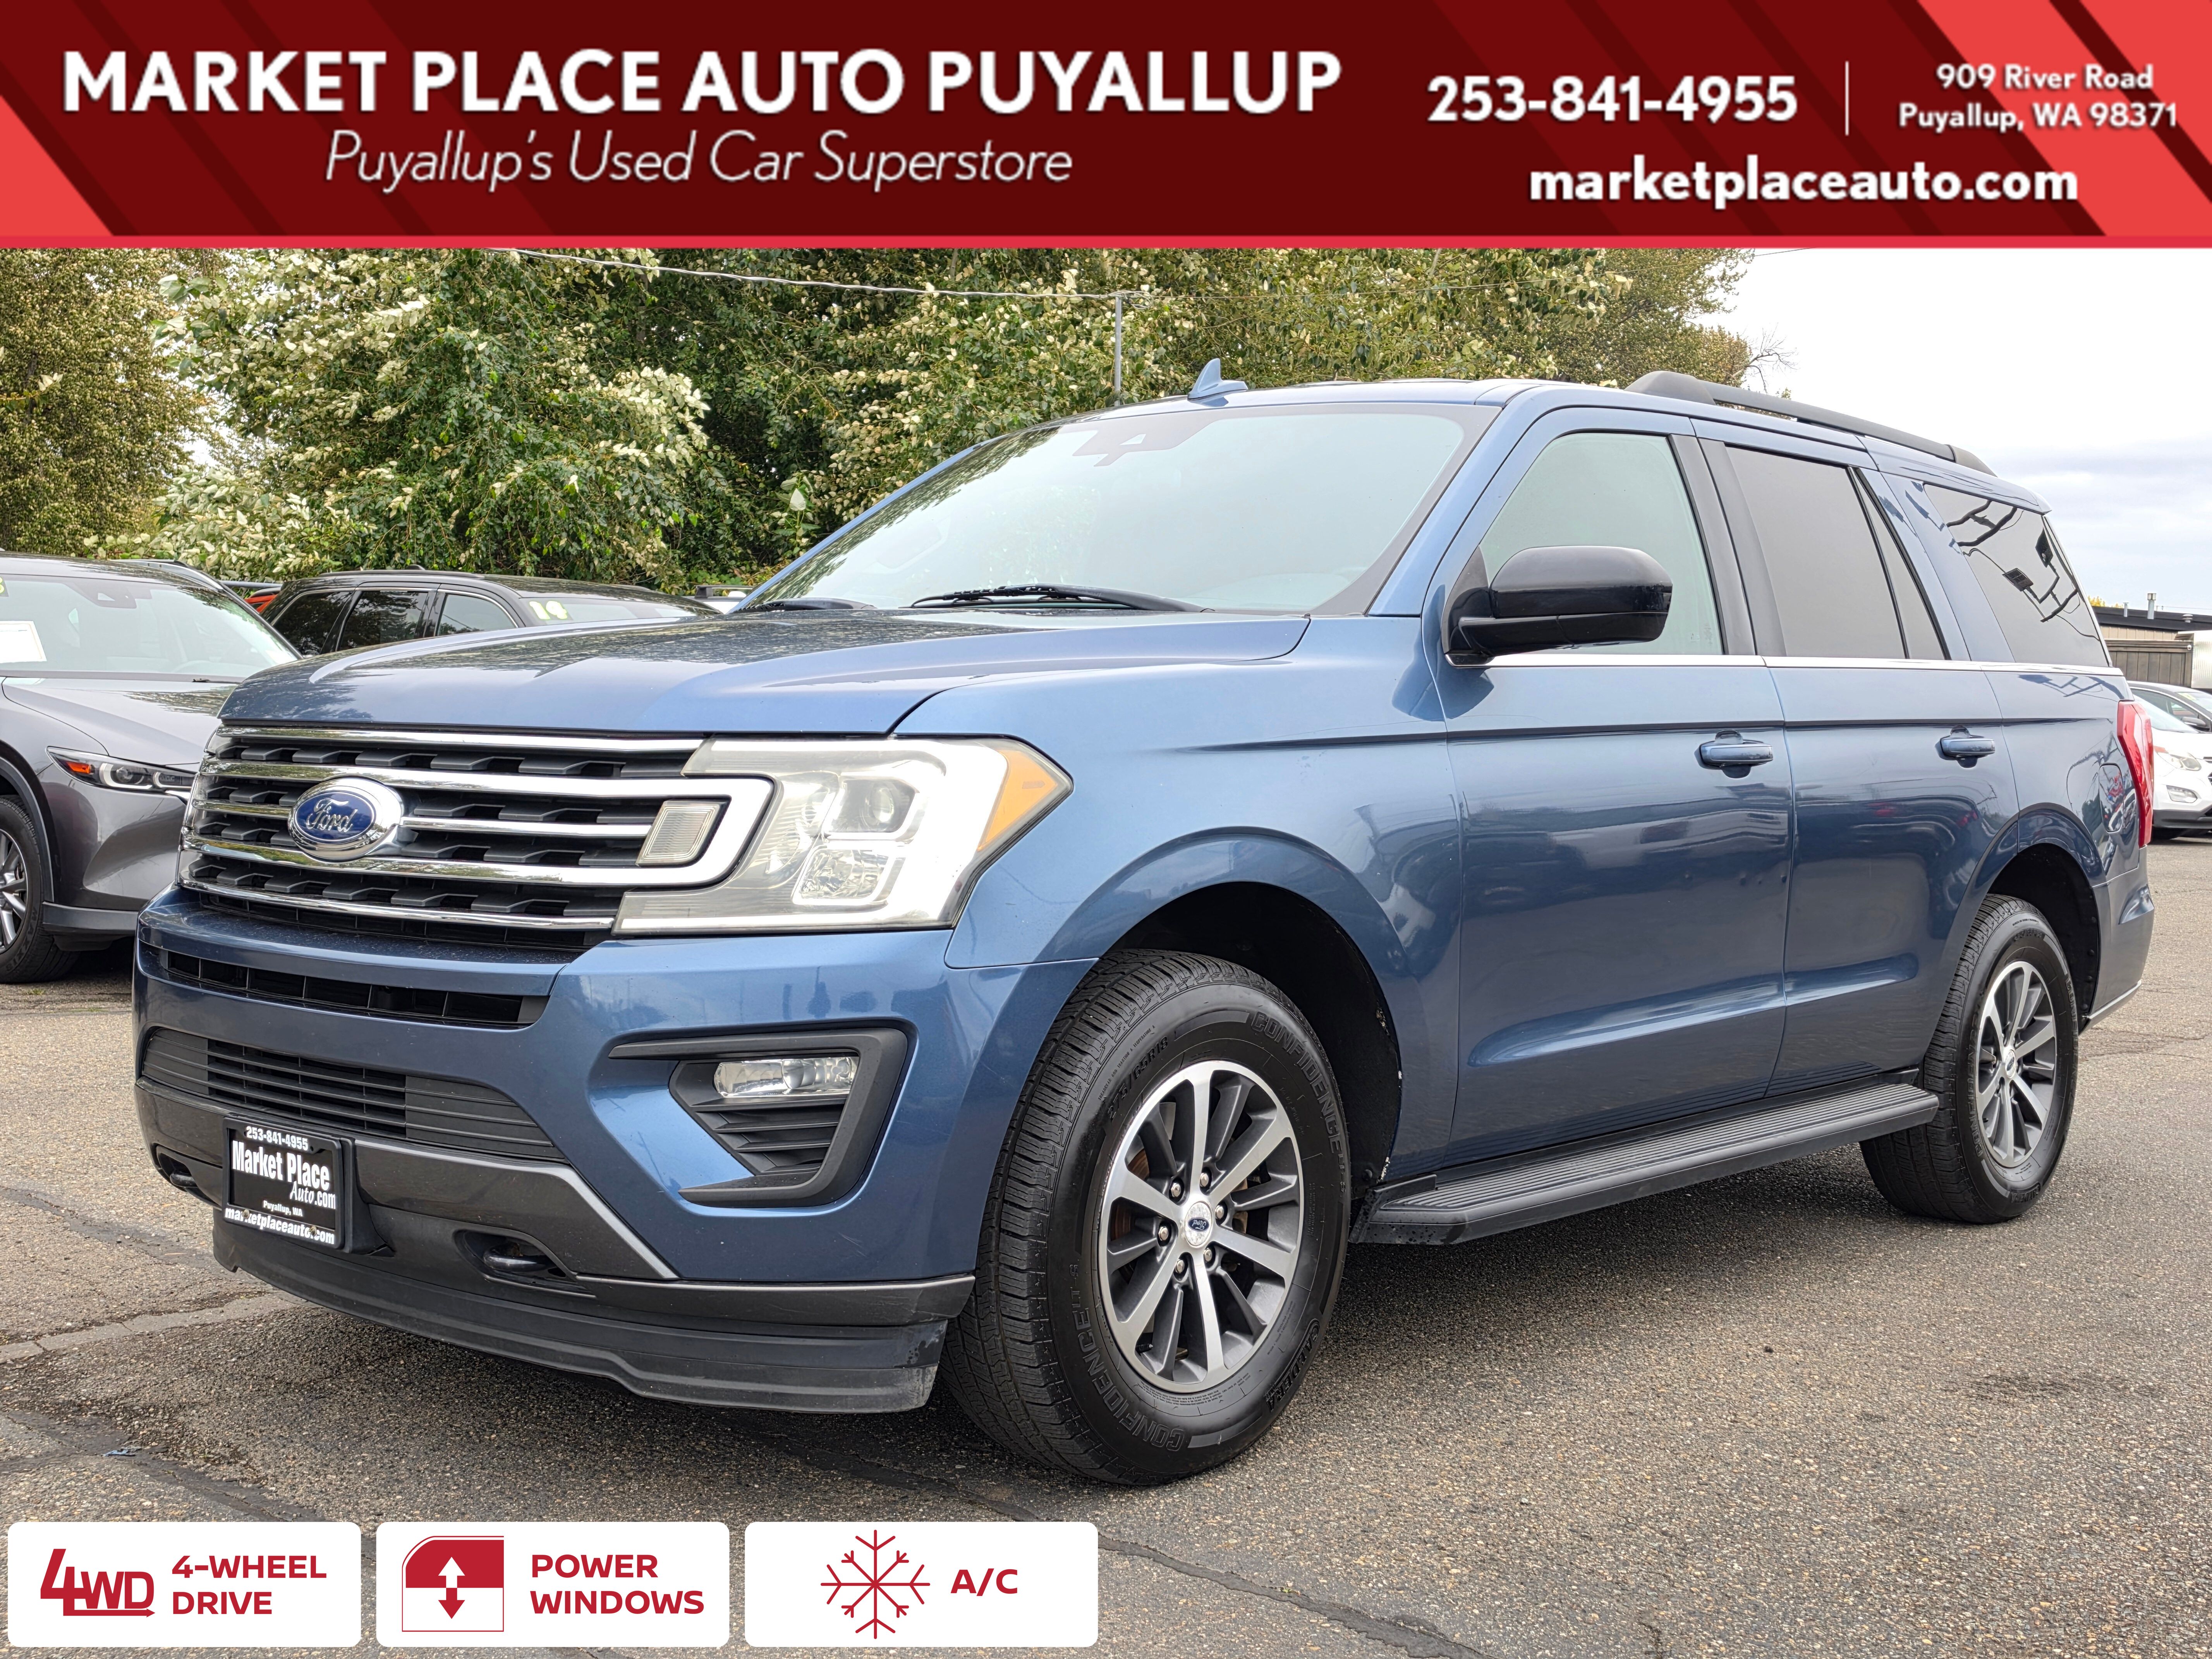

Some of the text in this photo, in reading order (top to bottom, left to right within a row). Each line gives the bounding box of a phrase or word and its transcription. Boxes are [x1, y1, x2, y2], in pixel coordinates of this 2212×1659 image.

[306, 798, 358, 833] Ford
[1117, 1052, 1130, 1068] TRACTION
[1133, 1029, 1151, 1048] TEMPERATURE
[1107, 1036, 1168, 1119] 275/65R18
[1251, 1011, 1341, 1154] CONFIDENCE
[246, 1126, 308, 1151] 253-841-4955
[232, 1140, 330, 1191] Market Place
[263, 1200, 303, 1217] Puyallup, WA
[1192, 1219, 1207, 1230] Ford
[1072, 1308, 1184, 1451] CONFIDENCE
[1264, 1320, 1320, 1412] CALDERA
